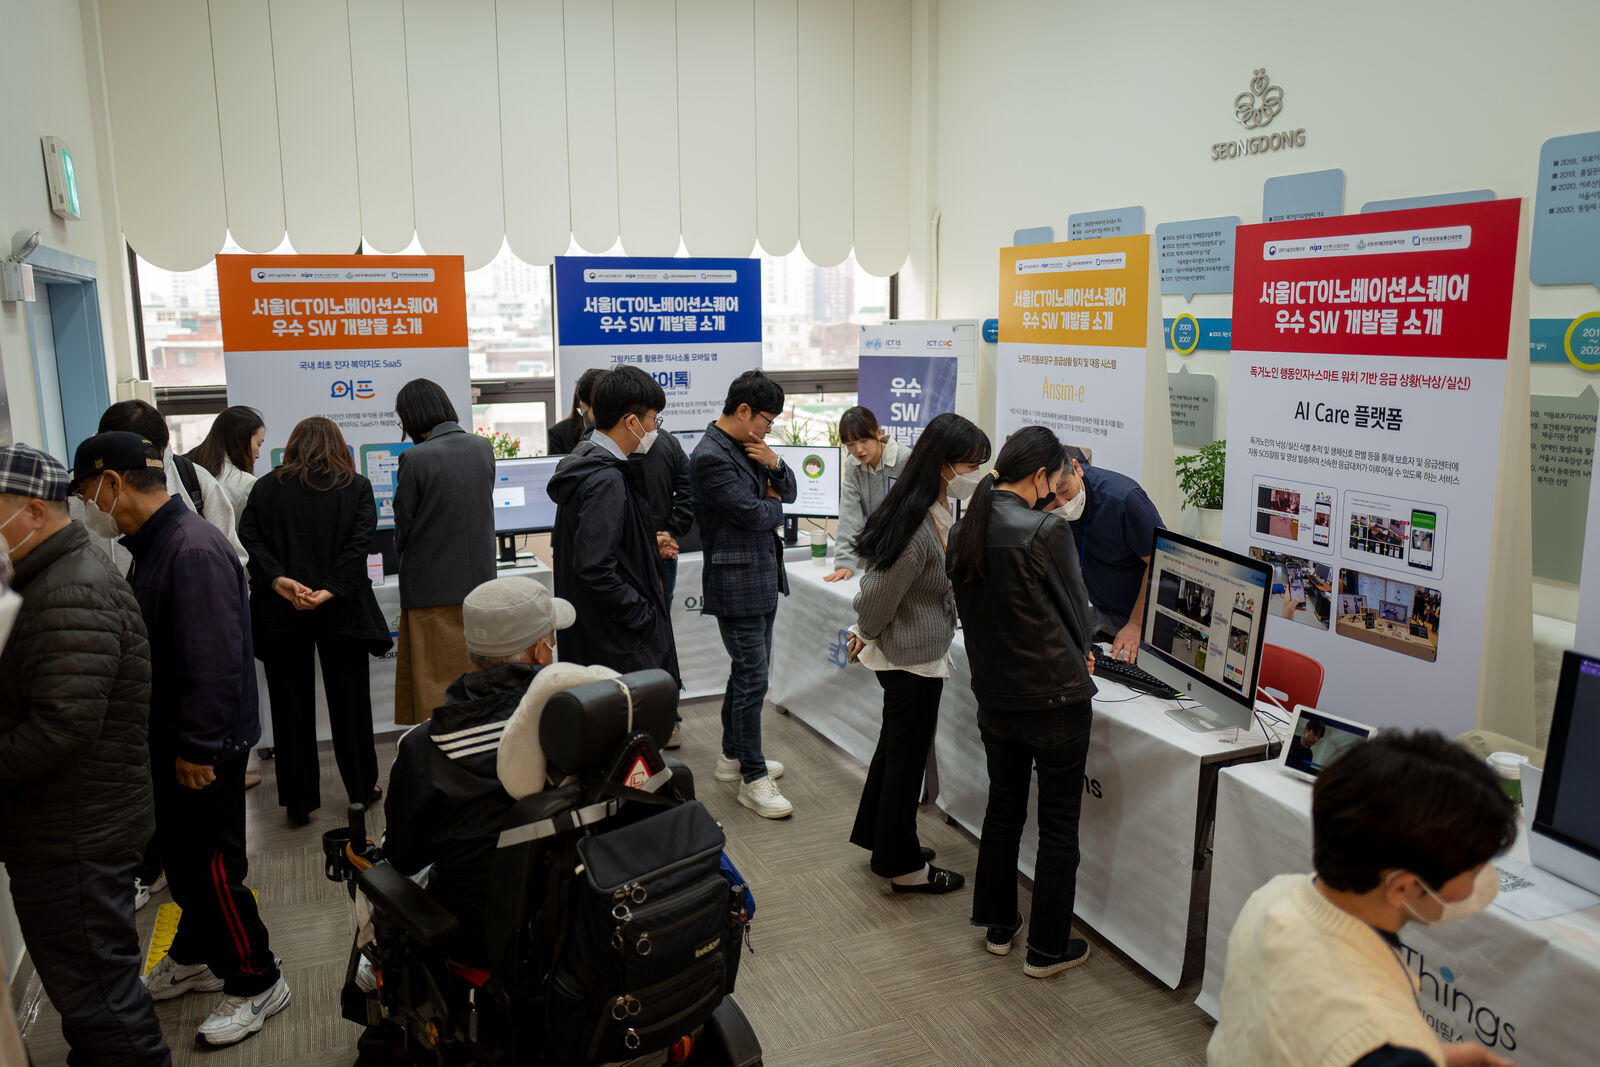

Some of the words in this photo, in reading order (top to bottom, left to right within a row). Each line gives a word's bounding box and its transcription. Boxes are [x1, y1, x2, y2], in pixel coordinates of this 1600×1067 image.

[1211, 128, 1306, 160] SEONGDONG
[1310, 244, 1322, 252] nipa
[1014, 287, 1126, 308] 서울ICT이노베이션스퀘어
[1260, 274, 1469, 304] 서울ICT이노베이션스퀘어
[252, 298, 438, 316] 서울ICT이노베이션스퀘어
[584, 297, 739, 313] 서울ICT이노베이션스퀘어
[272, 320, 304, 336] 우수
[308, 320, 337, 336] SW
[341, 318, 388, 335] 개발물
[393, 318, 422, 335] 소개
[600, 316, 627, 333] 우수
[630, 316, 654, 332] SW
[658, 316, 697, 332] 개발물
[700, 316, 725, 331] 소개
[1022, 313, 1040, 329] 우수
[1041, 313, 1059, 329] SW
[1061, 312, 1090, 330] 개발물
[1092, 311, 1113, 330] 소개
[1275, 310, 1305, 334] 우수
[1309, 311, 1340, 334] SW
[1344, 309, 1398, 335] 개발물
[1402, 308, 1443, 335] 소개
[300, 361, 315, 370] 국내
[317, 360, 332, 370] 최초
[334, 360, 350, 369] 전자
[351, 360, 381, 369] 복약지도
[383, 359, 402, 368] SaaS
[611, 354, 642, 364] 그림카드를
[645, 354, 663, 363] 활용한
[665, 354, 690, 362] 의사소통
[691, 353, 709, 361] 모바일
[1054, 356, 1072, 367] 응급상황
[1084, 358, 1088, 367] 및
[1090, 358, 1100, 369] 대응
[1100, 359, 1117, 369] 시스템
[890, 377, 921, 397] 우수
[1250, 366, 1279, 379] 독거노인
[1280, 368, 1339, 383] 행동인지+스마트
[1341, 370, 1358, 384] 워치
[1360, 371, 1377, 386] 기반
[1379, 372, 1398, 386] 응급
[1400, 373, 1471, 391] 상황(낙상/실신)
[1042, 376, 1085, 403] Ansim-e
[890, 402, 920, 422] SW
[1294, 401, 1310, 420] AI
[1315, 402, 1350, 424] Care
[1354, 405, 1403, 431] 플랫폼
[1355, 450, 1366, 460] 판별
[1368, 451, 1380, 461] 등을
[1381, 453, 1394, 463] 통해
[1396, 455, 1415, 466] 보호자
[1416, 458, 1423, 467] 및
[1424, 458, 1459, 472] 응급센터에
[1538, 465, 1556, 473] 서울시
[1320, 458, 1337, 468] 신속한
[1369, 464, 1393, 476] 이루어질
[1395, 469, 1401, 477] 수
[1402, 469, 1422, 480] 있도록
[1424, 472, 1437, 482] 하는
[1438, 474, 1460, 485] 서비스
